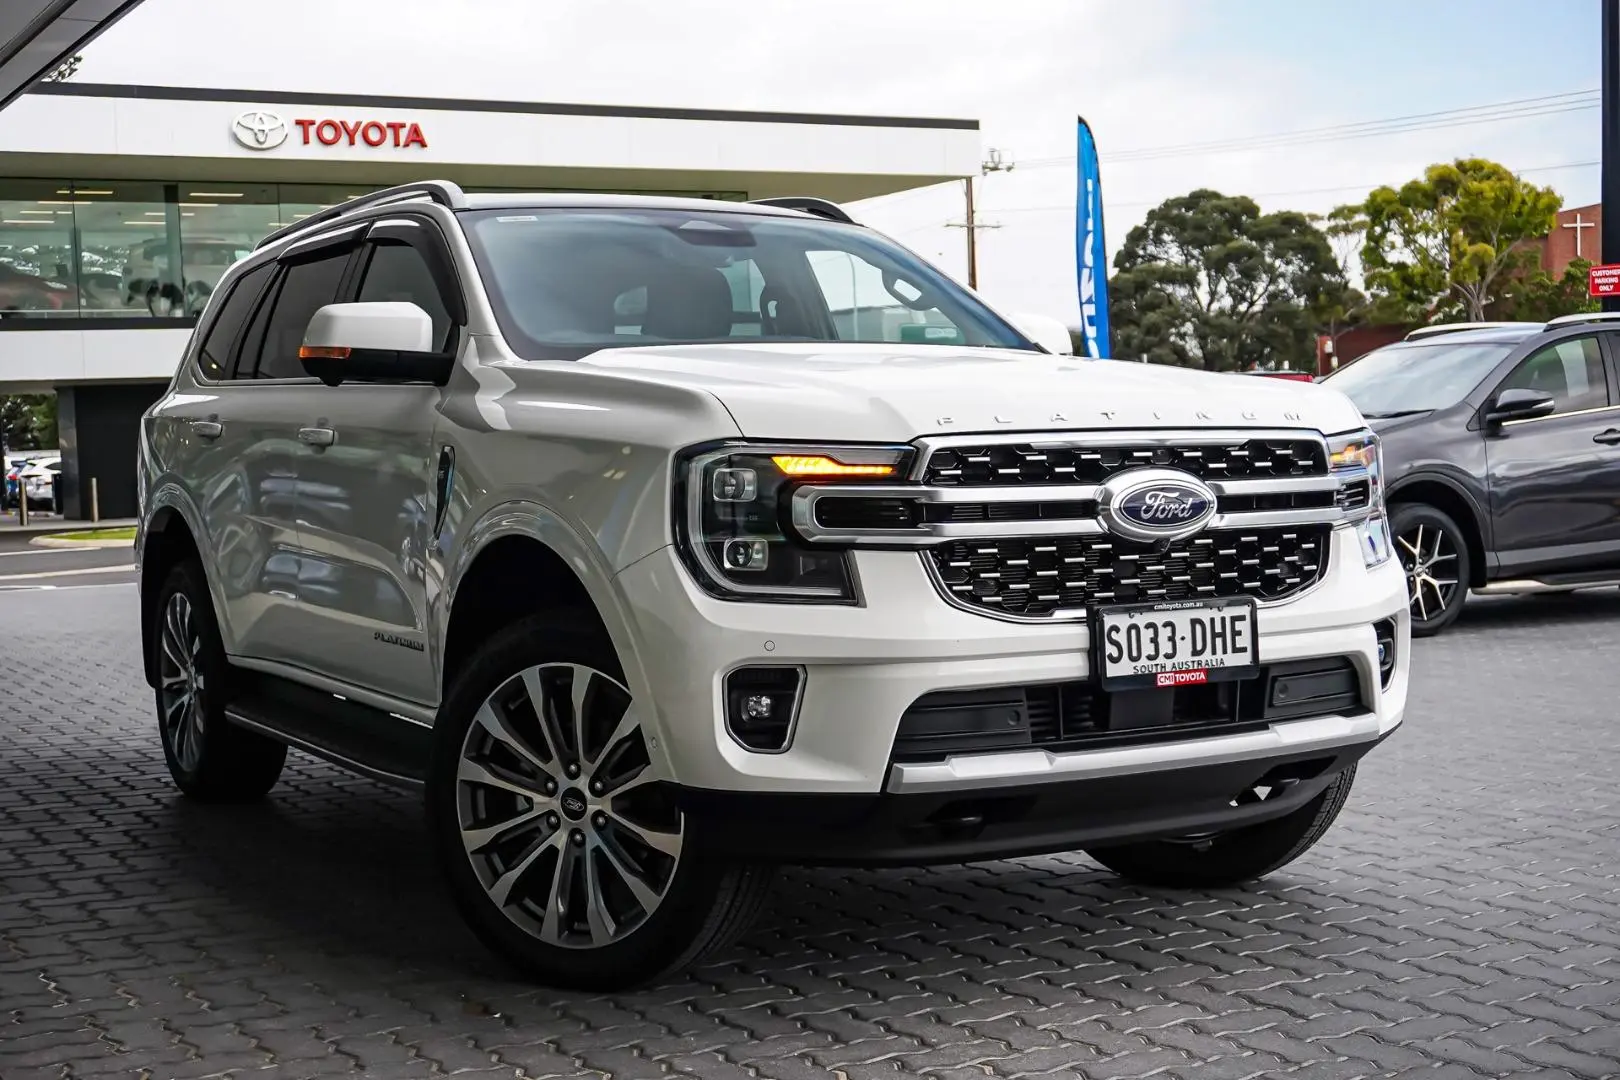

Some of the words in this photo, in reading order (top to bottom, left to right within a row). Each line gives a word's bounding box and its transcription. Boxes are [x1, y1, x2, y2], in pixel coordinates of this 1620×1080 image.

[295, 119, 428, 148] TOYOTA
[1140, 491, 1193, 520] Ford
[1154, 601, 1204, 611] cmitoyota.com.au
[1133, 660, 1167, 674] SOUTH
[1171, 658, 1225, 670] AUSTRALIA
[1158, 673, 1174, 685] CMI
[1175, 672, 1205, 682] TOYOTA
